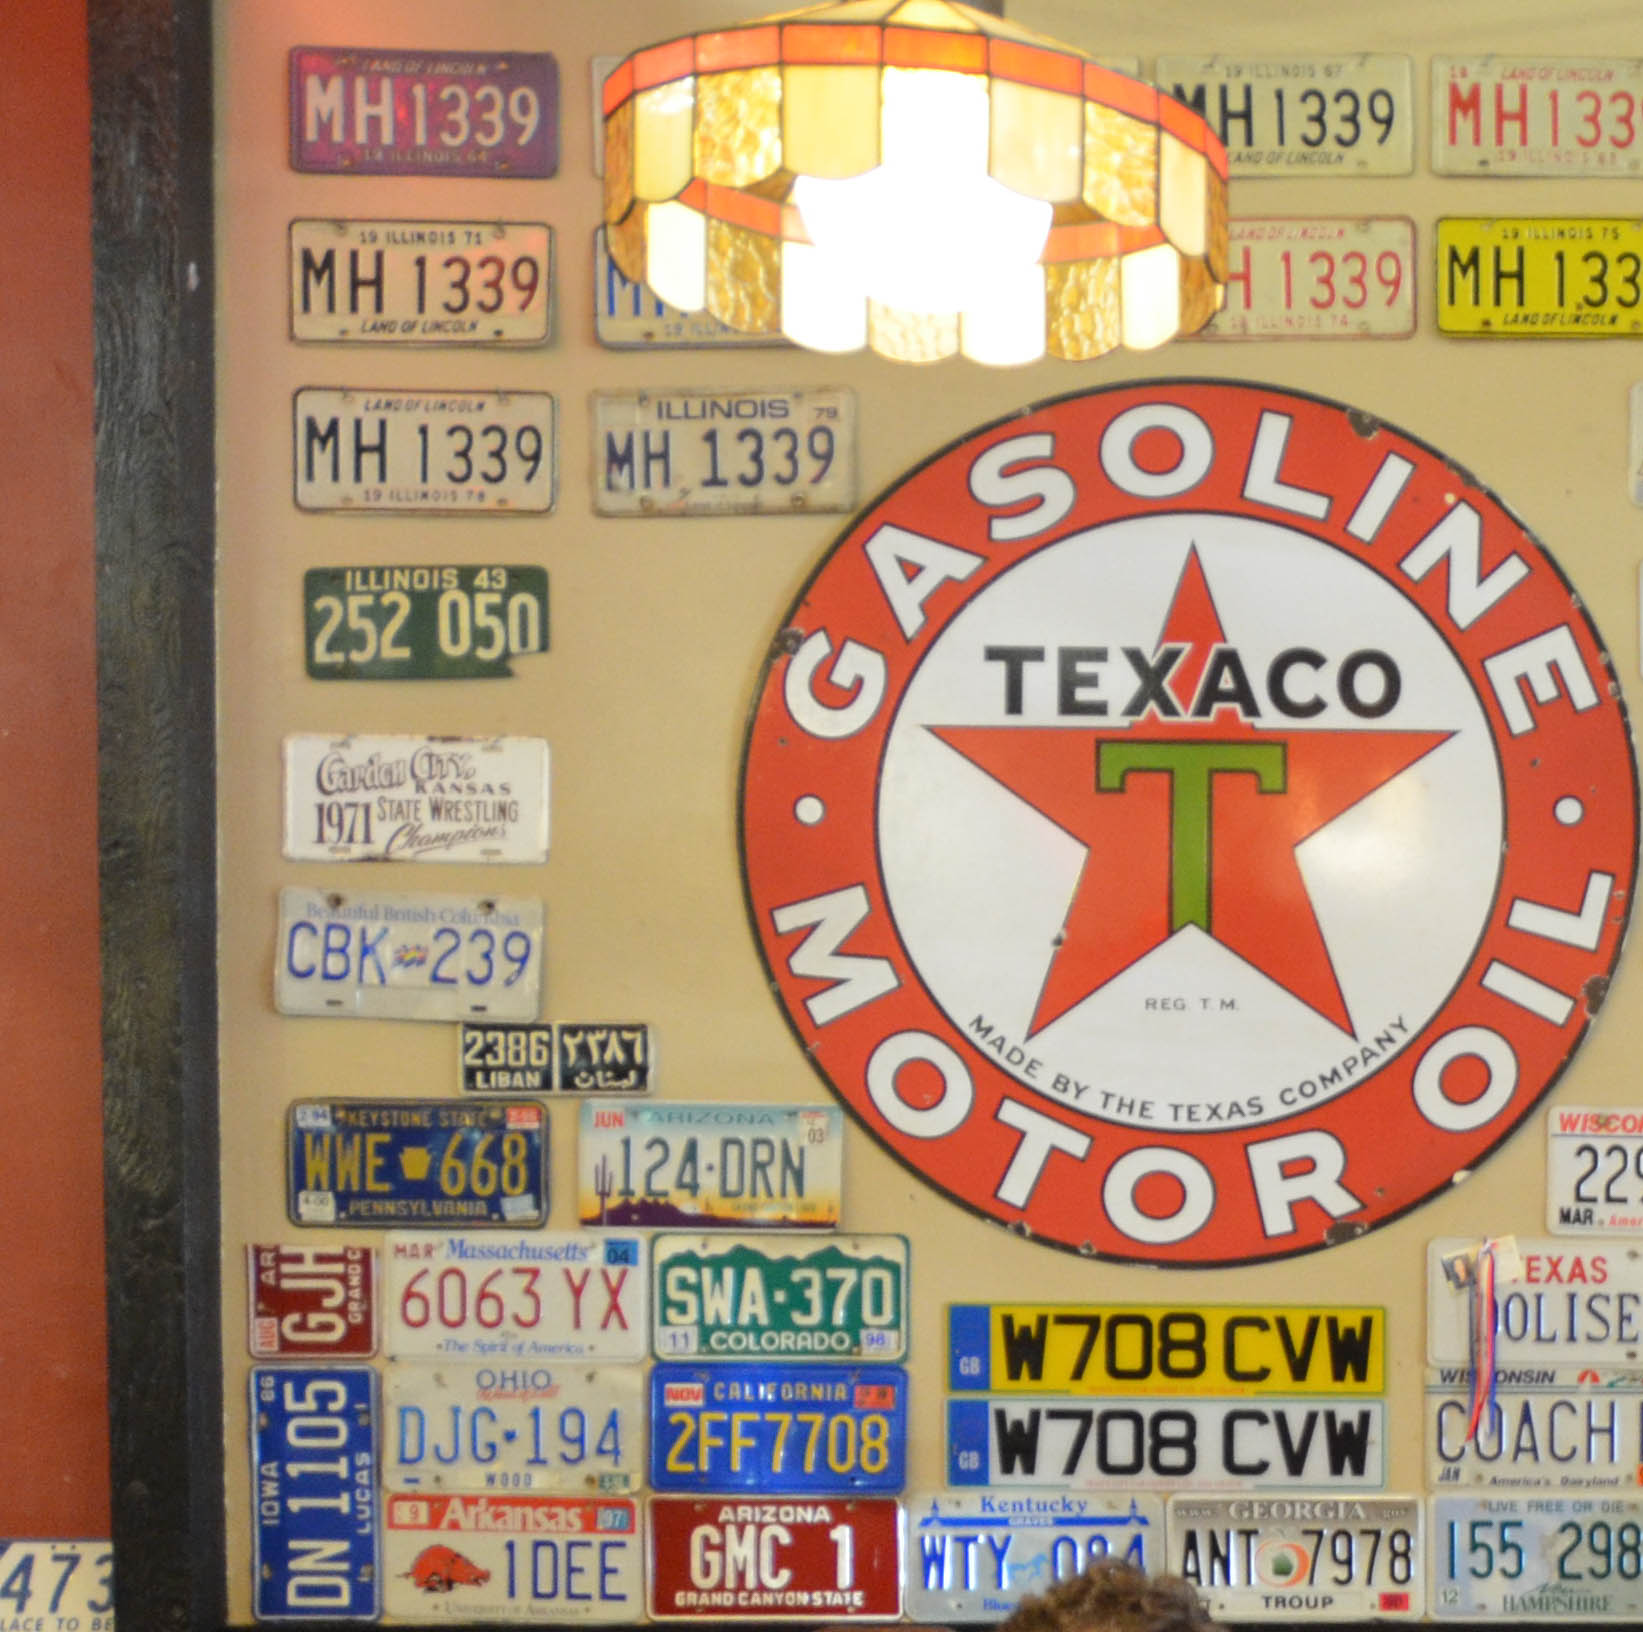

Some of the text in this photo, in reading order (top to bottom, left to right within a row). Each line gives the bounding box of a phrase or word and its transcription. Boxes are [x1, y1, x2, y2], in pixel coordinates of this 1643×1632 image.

[304, 416, 544, 484] MH 1339
[345, 568, 508, 592] ILLINOIS 43
[784, 401, 1600, 741] GASOLINE
[312, 591, 540, 664] 252 050
[984, 645, 1401, 719] TEXACO
[414, 782, 511, 796] KANSAS
[314, 802, 373, 846] 1971
[286, 920, 532, 986] CBK 239
[464, 1029, 549, 1068] 2386
[474, 1070, 542, 1089] LIBAN
[771, 869, 1616, 1246] MOTOR OIL
[968, 1014, 1412, 1123] MADE BY THE TEXAS COMPANY
[303, 1133, 527, 1196] WWE 668
[348, 1201, 487, 1217] PENNSYLVANIA
[1560, 1208, 1594, 1226] MAR
[444, 1239, 589, 1262] Massachusetts
[606, 1247, 630, 1265] 04
[476, 1370, 553, 1390] OHIO
[959, 1315, 1373, 1383] GB W708 CVW
[667, 1412, 890, 1474] 2FF7708
[958, 1408, 1372, 1477] GB W708 CVW
[261, 1461, 281, 1528] IOWA
[355, 1452, 373, 1535] LUCAS
[718, 1505, 830, 1524] ARIZONA
[980, 1496, 1088, 1516] Kentucky
[287, 1538, 351, 1609] DN
[1263, 1596, 1334, 1610] TROUP
[58, 1618, 79, 1631] TO
